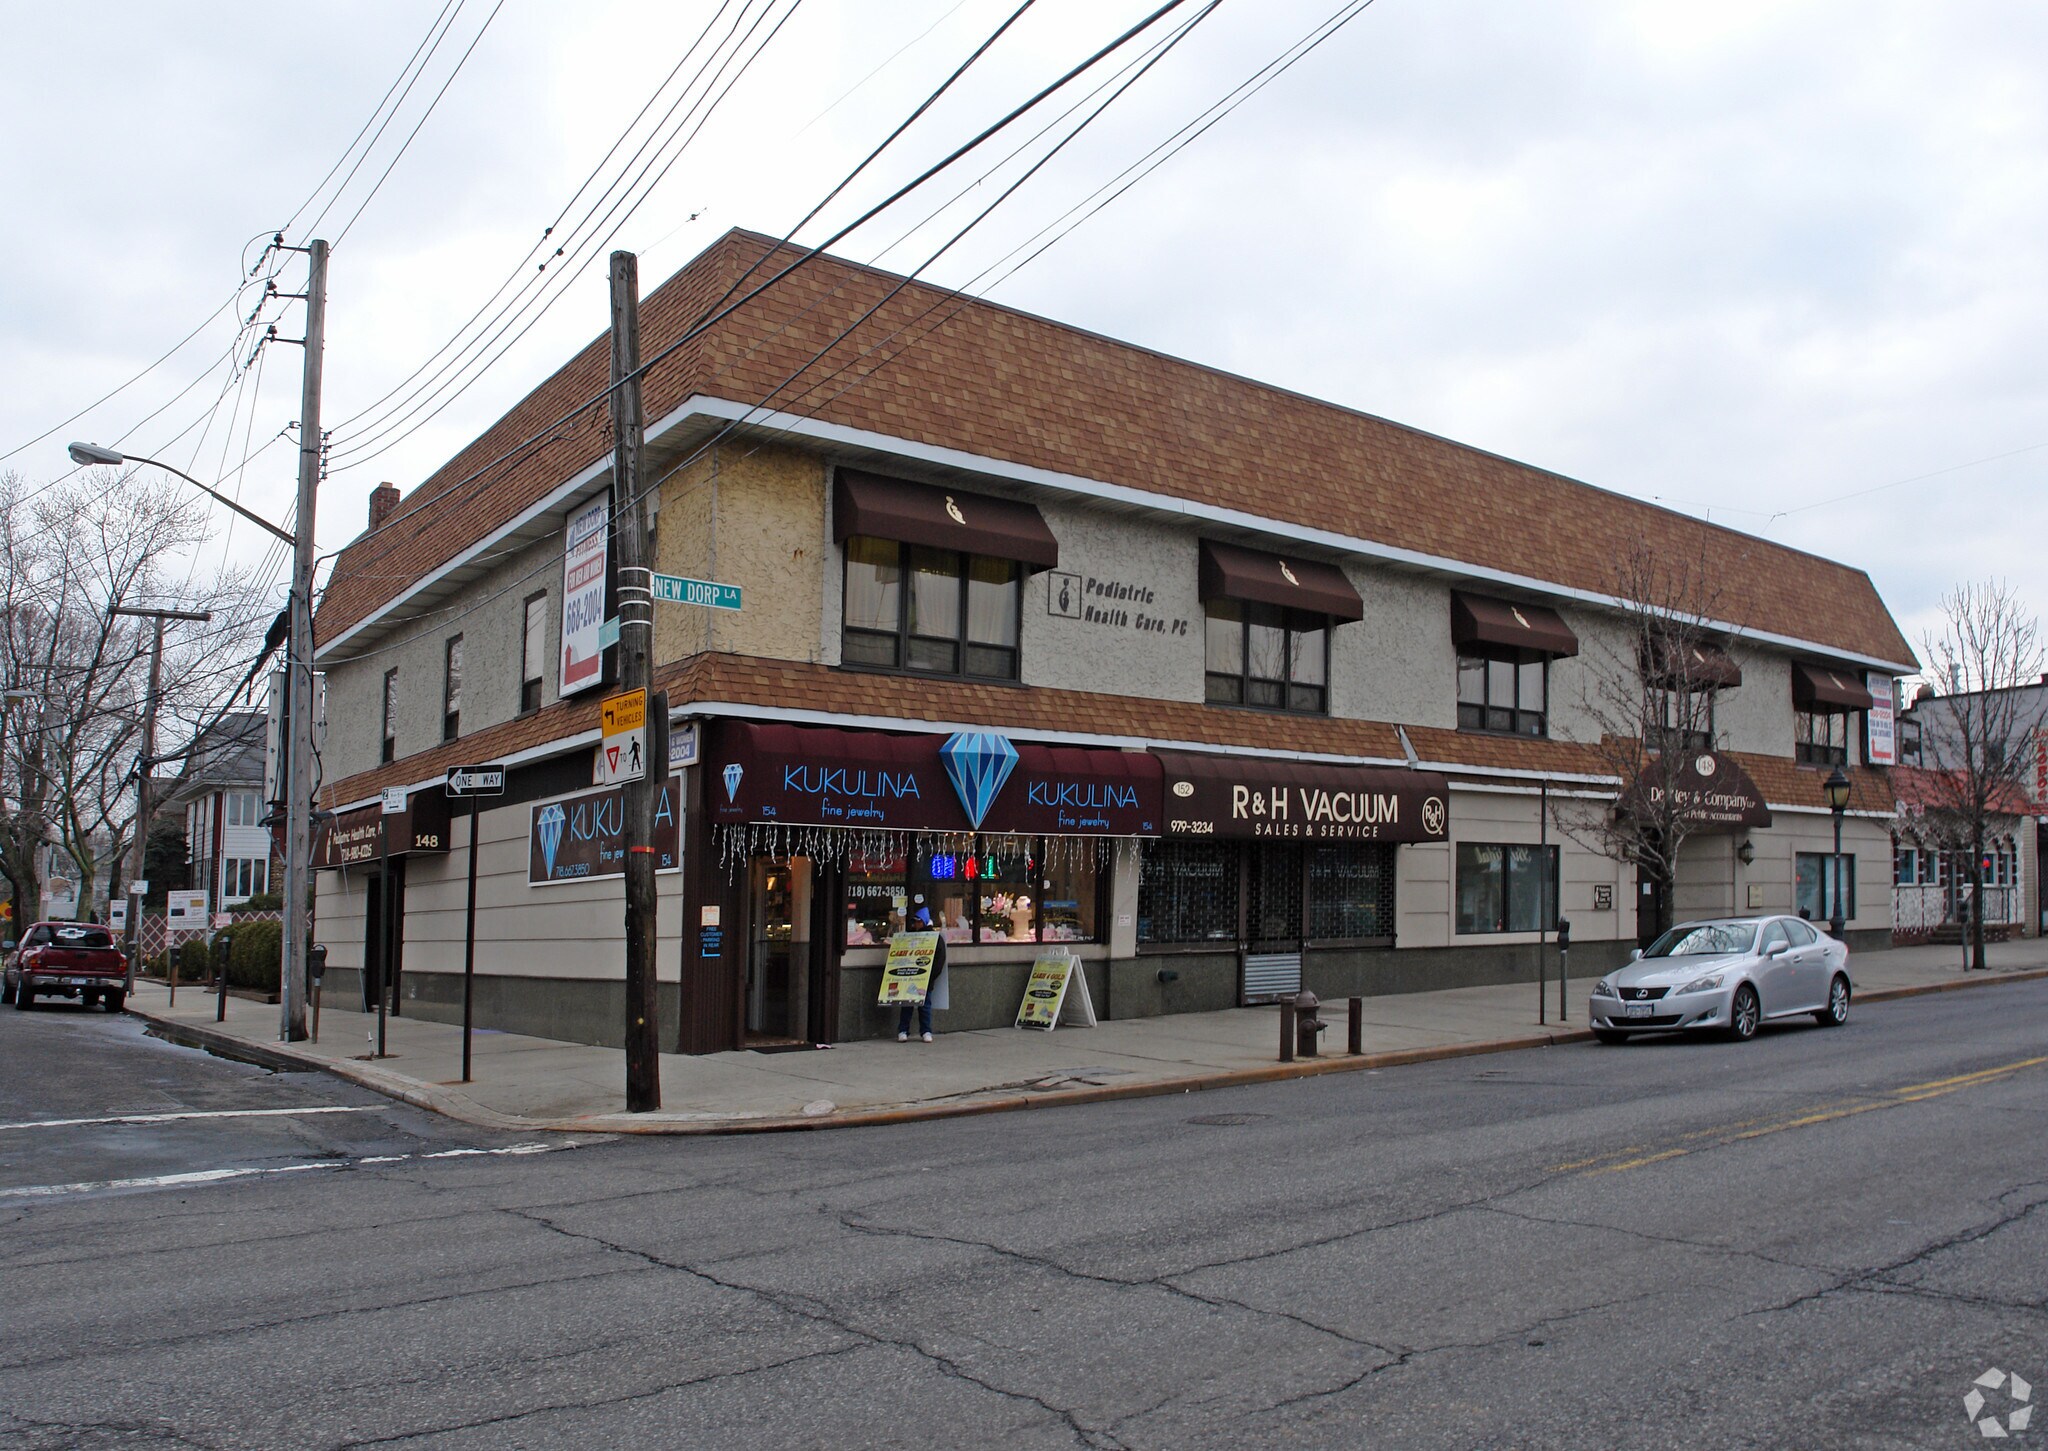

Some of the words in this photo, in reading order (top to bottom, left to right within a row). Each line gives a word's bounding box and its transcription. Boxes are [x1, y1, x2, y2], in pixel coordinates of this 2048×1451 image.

[656, 578, 682, 599] NEW
[688, 583, 720, 604] DORP
[724, 589, 736, 599] LA
[1086, 578, 1154, 604] Pediatric
[566, 586, 602, 636] 668-2004
[1085, 605, 1128, 627] Health
[1135, 613, 1166, 634] Care,
[1172, 619, 1188, 636] PC
[616, 696, 642, 711] TURNING
[616, 711, 642, 726] VEHICLES
[620, 753, 627, 763] TO
[456, 775, 472, 786] ONE
[482, 774, 500, 785] WAY
[784, 764, 920, 799] KUKULINA
[1028, 781, 1138, 808] KUKULINA
[1176, 784, 1190, 795] 152
[821, 797, 842, 818] fine
[846, 801, 885, 821] jewelry
[1300, 788, 1398, 824] VACUUM
[1704, 791, 1748, 811] Company
[571, 786, 673, 842] KUKUA
[762, 806, 776, 816] 154
[1710, 811, 1743, 822] Accountants
[1058, 810, 1076, 828] fine
[1078, 812, 1110, 830] jewelry
[1142, 822, 1152, 830] 154
[1170, 820, 1214, 834] 979-3234
[1255, 822, 1298, 836] SALES
[1306, 824, 1314, 836] &
[1320, 824, 1378, 838] SERVICE
[415, 834, 438, 848] 148
[600, 841, 612, 864] fine
[662, 854, 672, 866] 154
[866, 886, 906, 897] 667-3850
